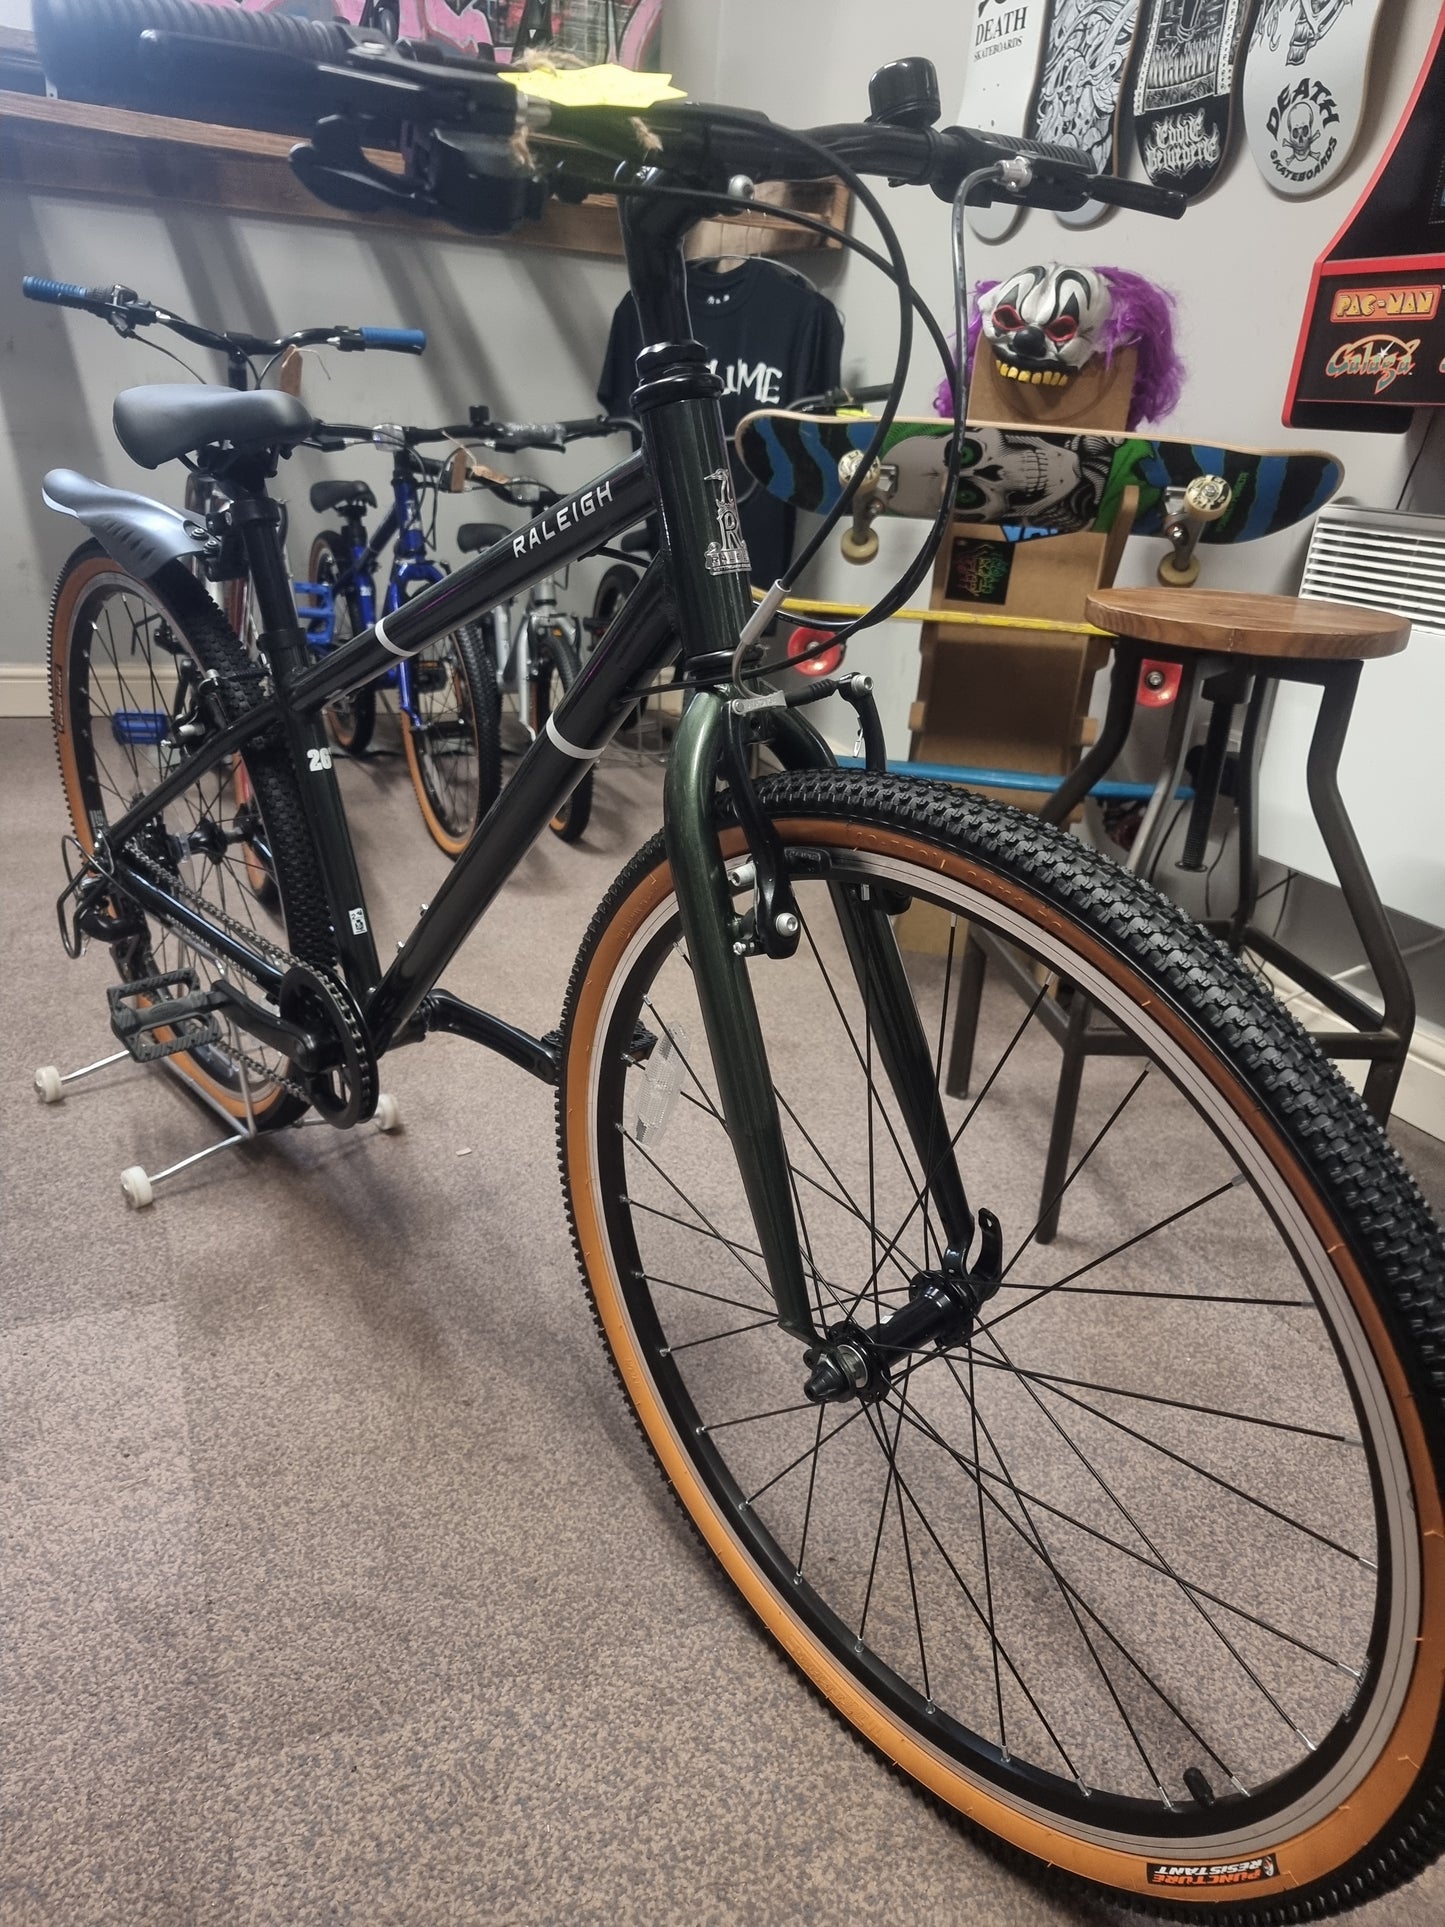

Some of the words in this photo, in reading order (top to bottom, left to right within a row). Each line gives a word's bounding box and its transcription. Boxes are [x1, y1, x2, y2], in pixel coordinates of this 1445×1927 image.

[975, 6, 1030, 47] DEATH
[973, 38, 1023, 63] SKATEBOARDS
[1266, 77, 1340, 142] DEATH
[1270, 136, 1338, 182] SKATEBOARDS
[1335, 290, 1434, 317] PAC-MAN
[512, 480, 614, 558] RALEIGH
[1152, 1869, 1261, 1885] PUNCTURE
[1155, 1858, 1263, 1876] RESISTANT
